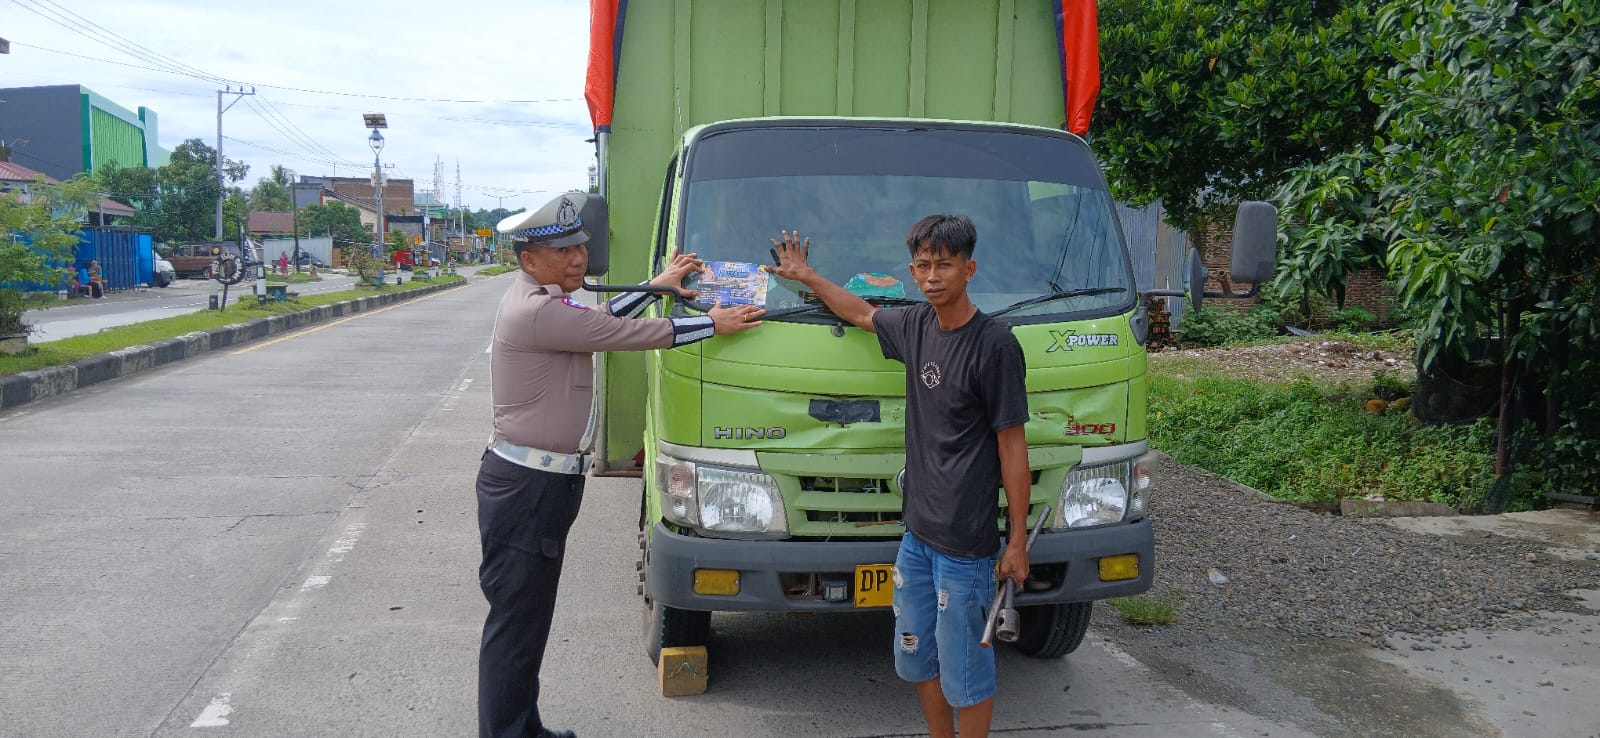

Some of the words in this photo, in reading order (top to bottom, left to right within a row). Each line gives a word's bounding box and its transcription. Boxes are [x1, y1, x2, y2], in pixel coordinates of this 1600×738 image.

[714, 427, 787, 440] HINO
[1064, 422, 1116, 436] 300
[860, 569, 888, 592] DP
